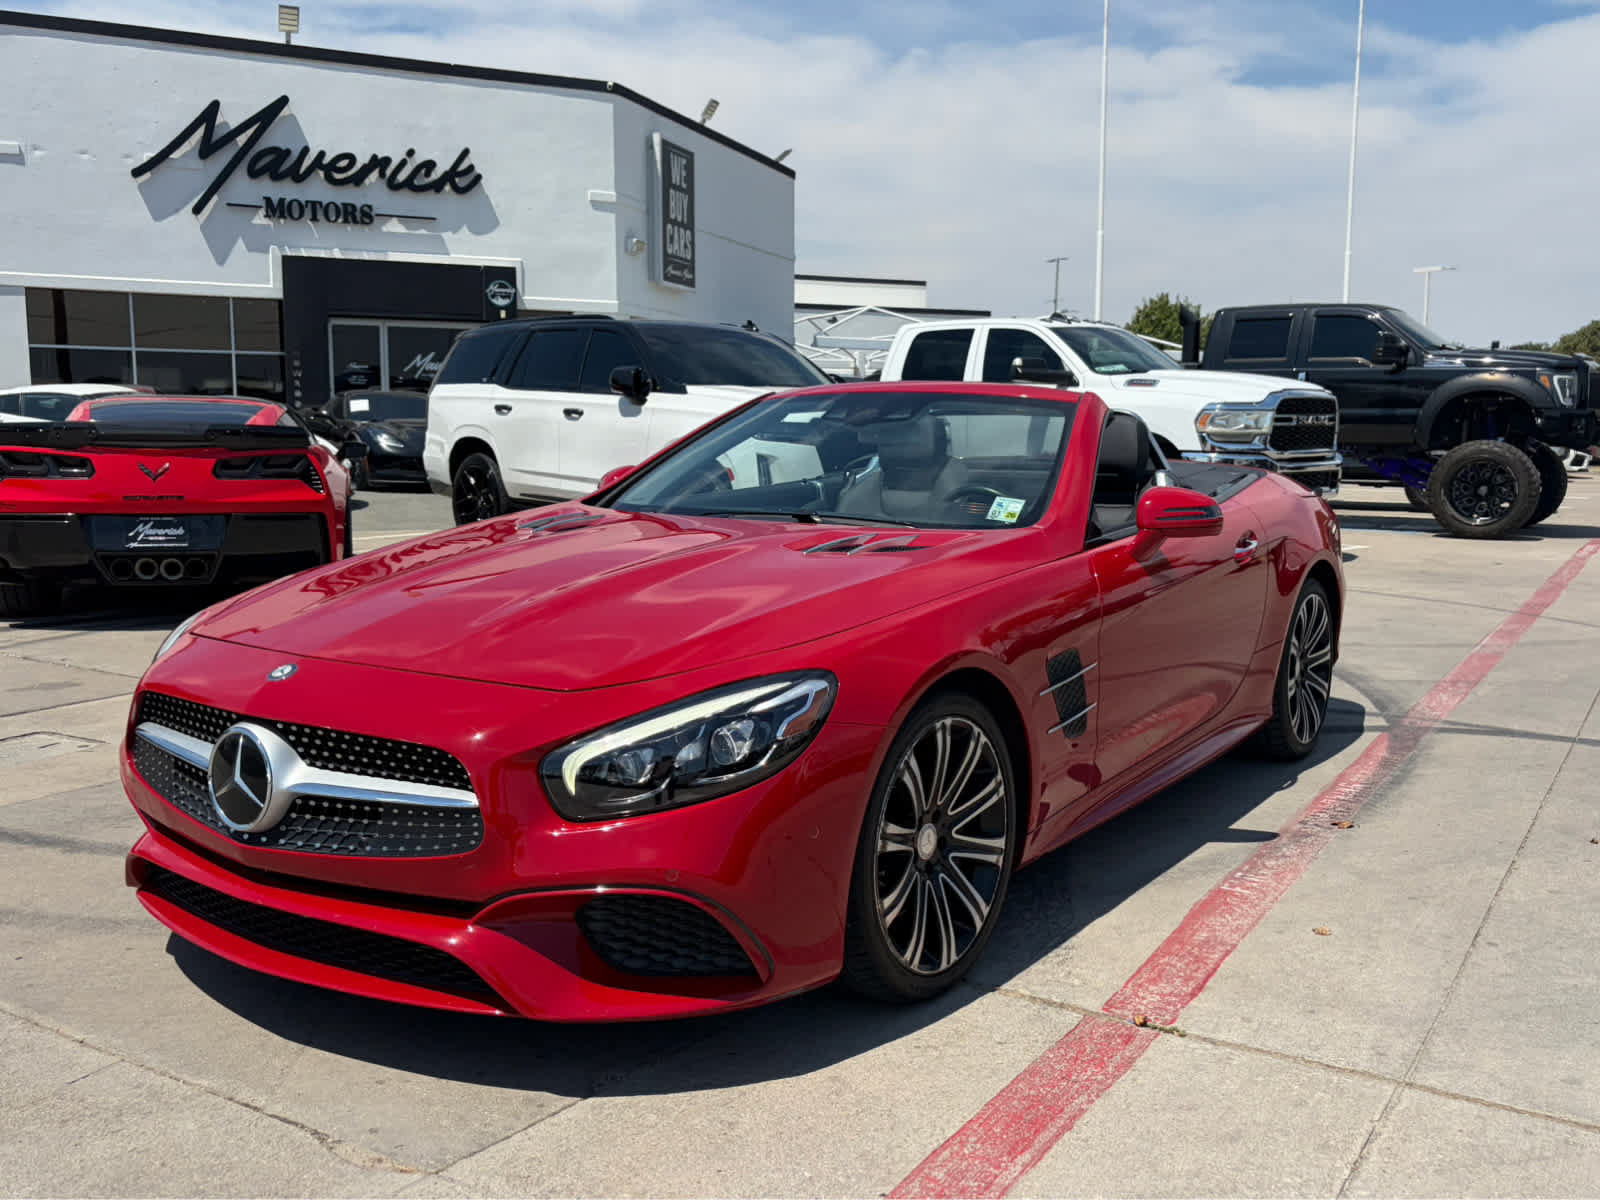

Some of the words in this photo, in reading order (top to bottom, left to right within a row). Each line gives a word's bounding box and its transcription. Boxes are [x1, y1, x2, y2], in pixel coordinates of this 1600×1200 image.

[131, 95, 482, 216] Maverick
[670, 152, 687, 189] WE
[262, 197, 375, 225] MOTORS
[669, 188, 689, 225] BUY
[666, 223, 692, 261] CARS
